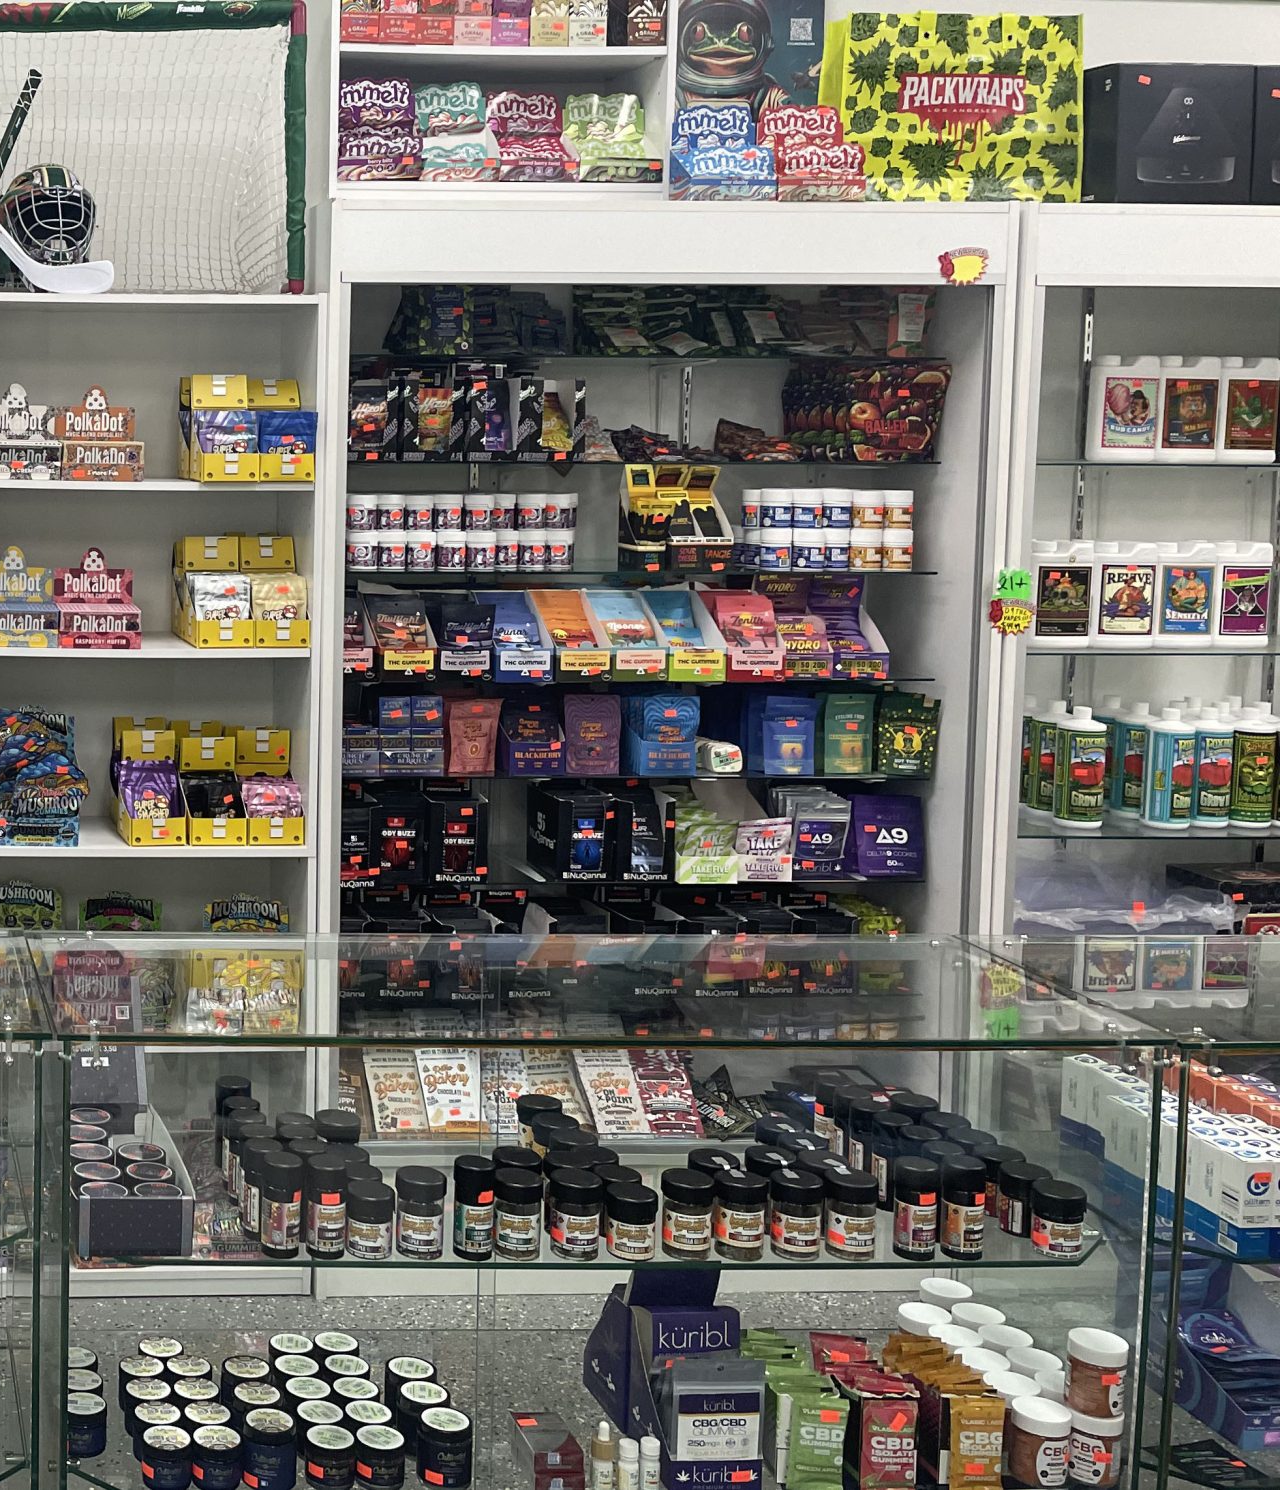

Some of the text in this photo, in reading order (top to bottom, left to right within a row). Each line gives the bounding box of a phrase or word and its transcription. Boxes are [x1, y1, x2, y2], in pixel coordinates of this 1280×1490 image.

[344, 84, 409, 106] mmelt
[901, 76, 1025, 112] PACKWRAPS
[680, 112, 748, 134] mmelt
[766, 112, 836, 133] mmelt
[787, 146, 860, 174] mmelt
[864, 418, 907, 433] BALLER
[1127, 425, 1151, 433] CANDY
[704, 549, 732, 559] TANGIE
[767, 582, 797, 592] HYDRO
[998, 576, 1027, 591] 21+
[376, 612, 421, 623] Twilight
[730, 615, 765, 626] Zenith
[446, 621, 491, 632] Twilight
[784, 639, 820, 650] HYDRO
[515, 751, 562, 759] BLACKBERRY
[134, 800, 155, 810] SUPER
[137, 809, 170, 819] SMASHED
[691, 864, 729, 874] TAKE FIVE
[745, 863, 784, 873] TAKE FIVE
[212, 900, 279, 919] MUSHROOM
[424, 1072, 470, 1094] Bakery
[375, 1081, 419, 1100] Bakery
[437, 1088, 462, 1096] CHOCOLATE
[605, 1096, 633, 1104] POINT
[659, 1321, 732, 1348] küribl
[703, 1399, 736, 1411] küribl
[692, 1418, 747, 1428] CBG/CBD
[692, 1427, 747, 1437] GUMMIES
[799, 1425, 843, 1441] CBD
[871, 1436, 914, 1451] CBD
[959, 1431, 1002, 1445] CBG
[1071, 1439, 1102, 1455] CBG
